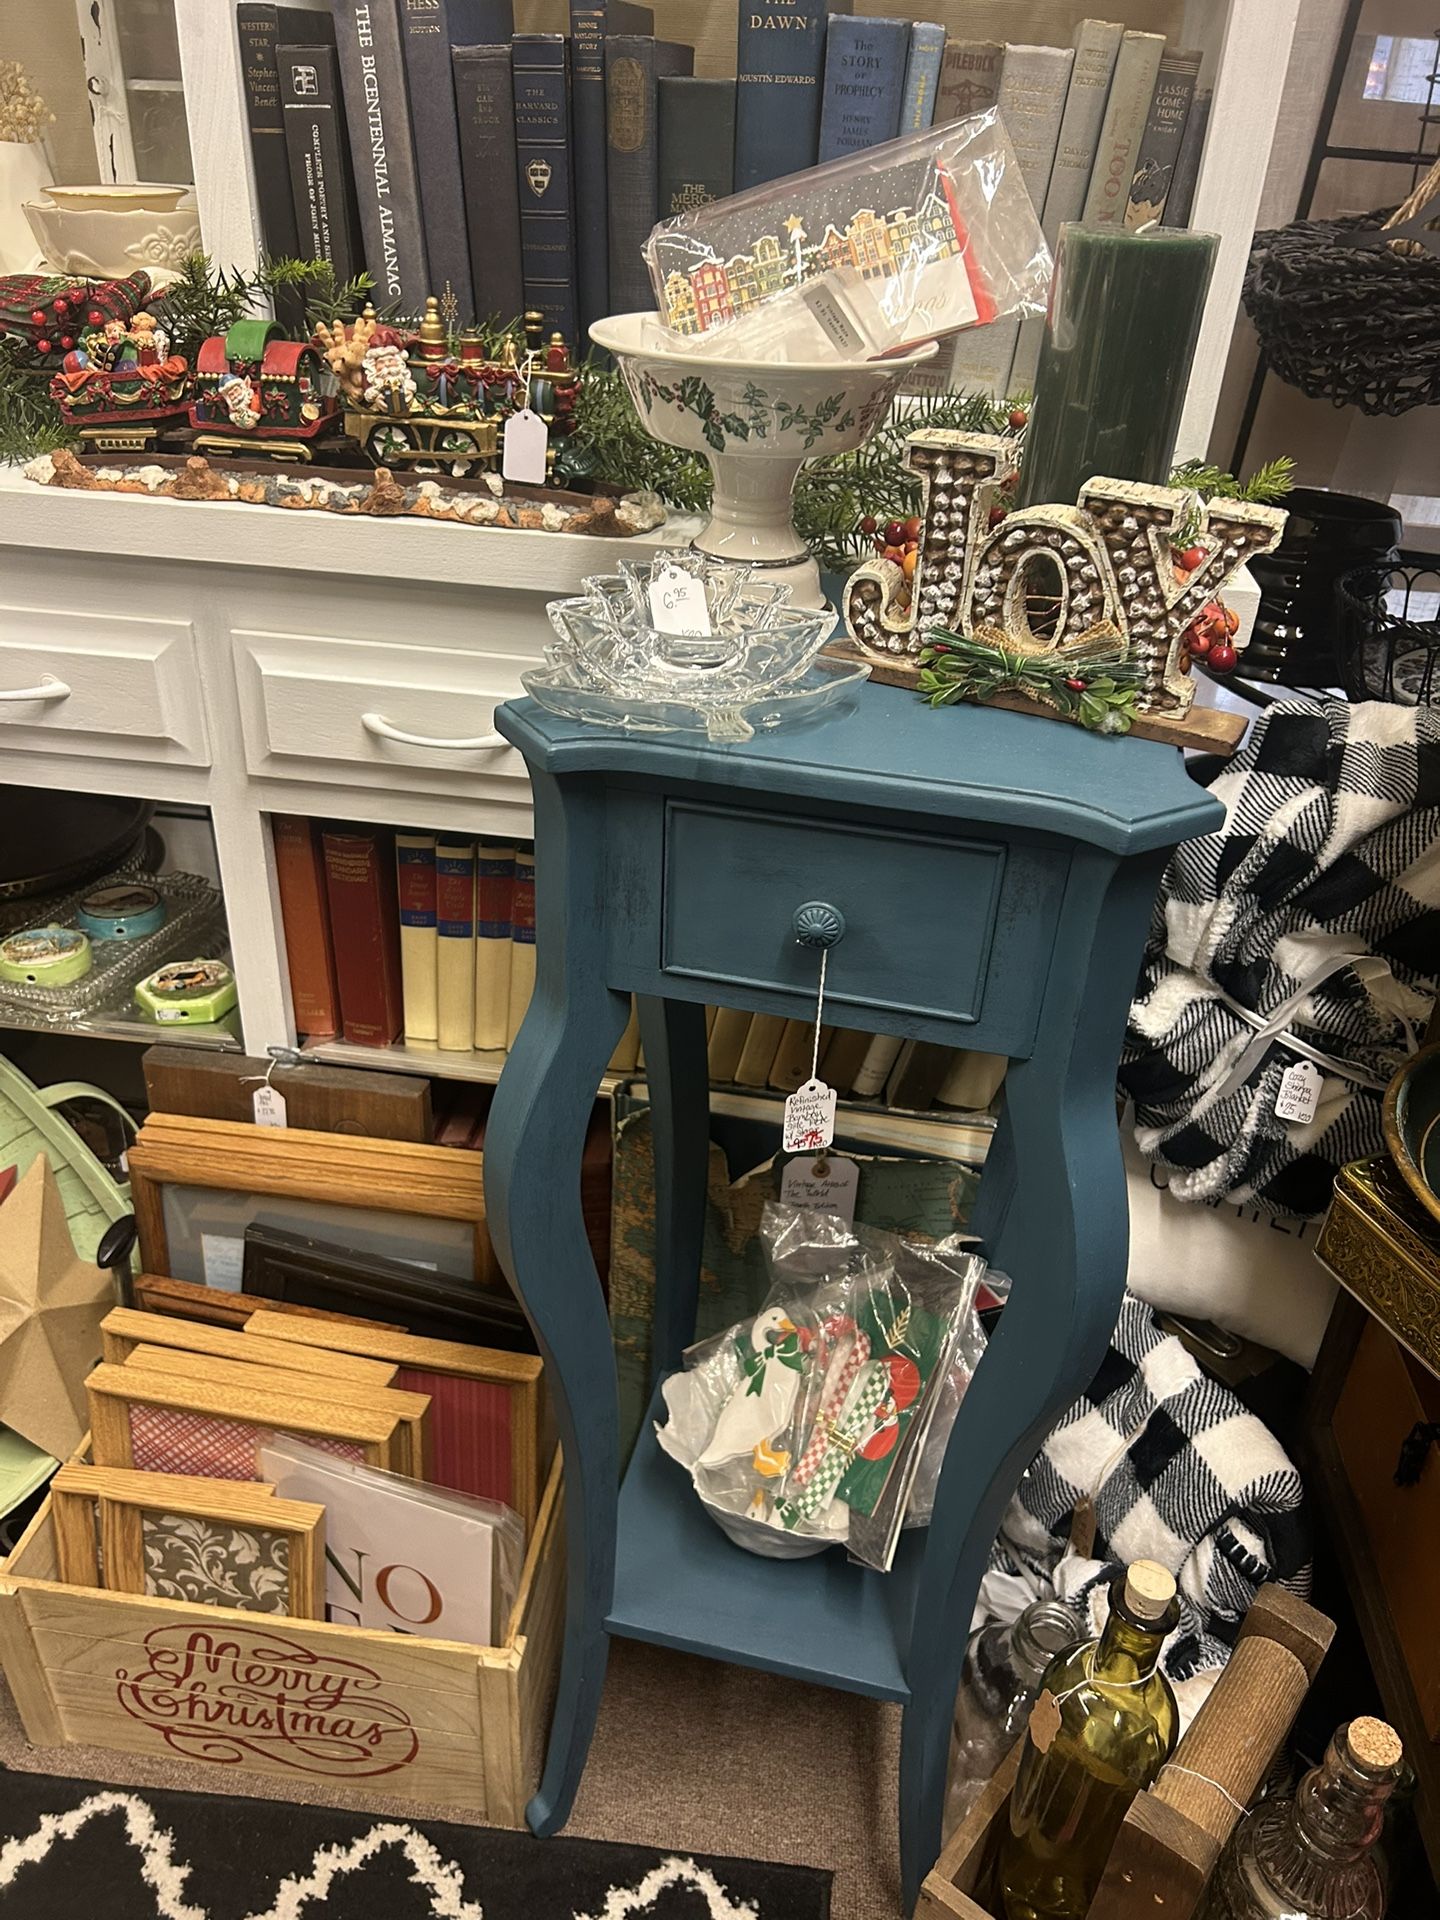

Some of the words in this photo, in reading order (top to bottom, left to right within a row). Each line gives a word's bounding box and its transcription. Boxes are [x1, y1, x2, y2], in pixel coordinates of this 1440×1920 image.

[240, 22, 275, 32] WESTERN
[355, 4, 373, 48] THE
[750, 14, 808, 30] DAWN
[248, 37, 270, 47] STAR
[852, 39, 875, 52] The
[841, 54, 883, 70] STORY
[774, 74, 816, 85] EDWARDS
[525, 88, 545, 97] THE
[834, 83, 885, 98] PROPHECY
[1158, 83, 1191, 98] LASSIE
[514, 102, 560, 111] HARVARD
[1157, 107, 1185, 121] HOME
[361, 54, 391, 199] BICENTENNIAL
[515, 115, 560, 125] CLASSICS
[304, 152, 315, 187] PROSE
[308, 187, 316, 202] OF
[681, 183, 706, 194] THE
[317, 180, 329, 220] POETRY
[671, 192, 717, 205] MERCK
[310, 203, 319, 230] JOHN
[321, 221, 331, 244] AND
[379, 204, 402, 296] ALMANAC
[330, 863, 368, 874] STANDARD
[789, 1090, 832, 1107] Refinished
[790, 1103, 822, 1114] Vintage
[147, 1630, 352, 1710] Merry
[128, 1670, 385, 1746] Christmas
